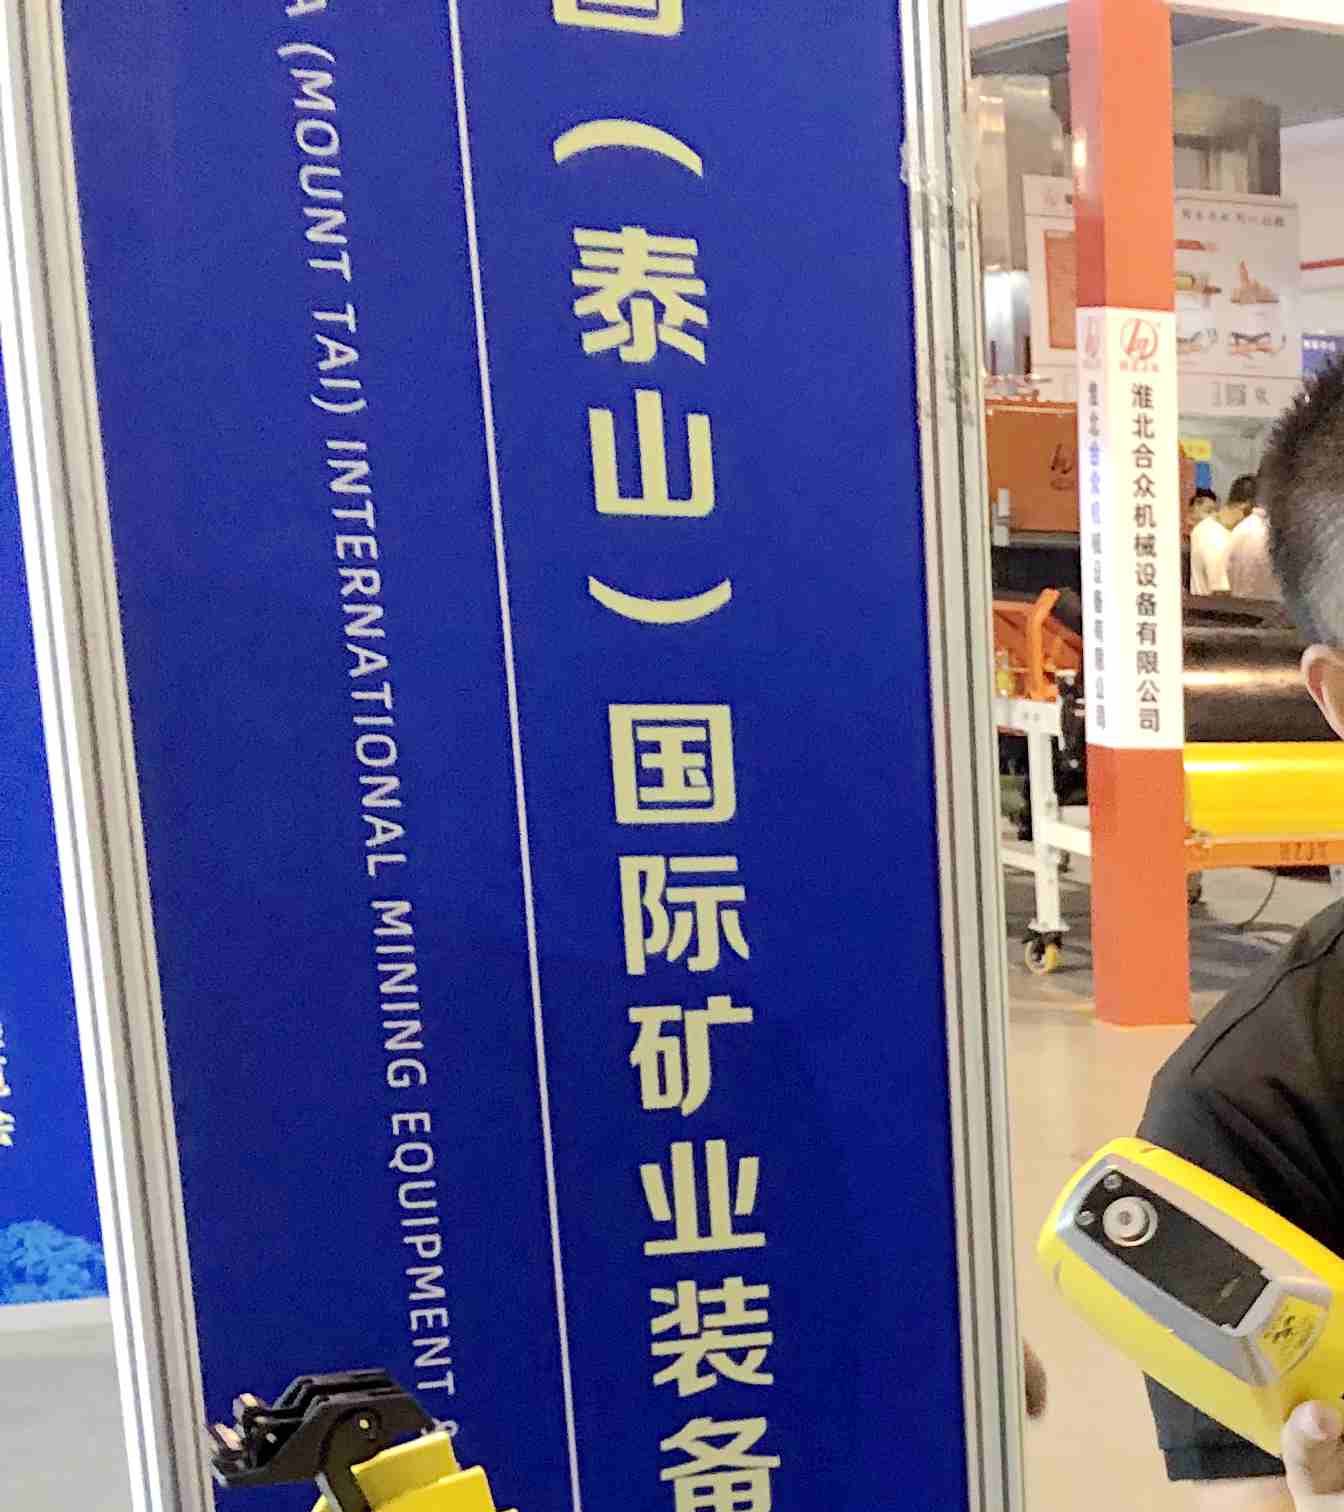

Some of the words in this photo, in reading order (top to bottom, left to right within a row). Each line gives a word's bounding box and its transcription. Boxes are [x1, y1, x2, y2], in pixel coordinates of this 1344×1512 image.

[277, 42, 351, 284] (MOUNT
[309, 302, 369, 417] TAI)
[322, 437, 407, 877] INTERNATIONAL
[1130, 382, 1161, 733] 淮北合众机械设备有限公司
[371, 899, 428, 1090] MINING
[388, 1109, 455, 1396] EQUIPMENT
